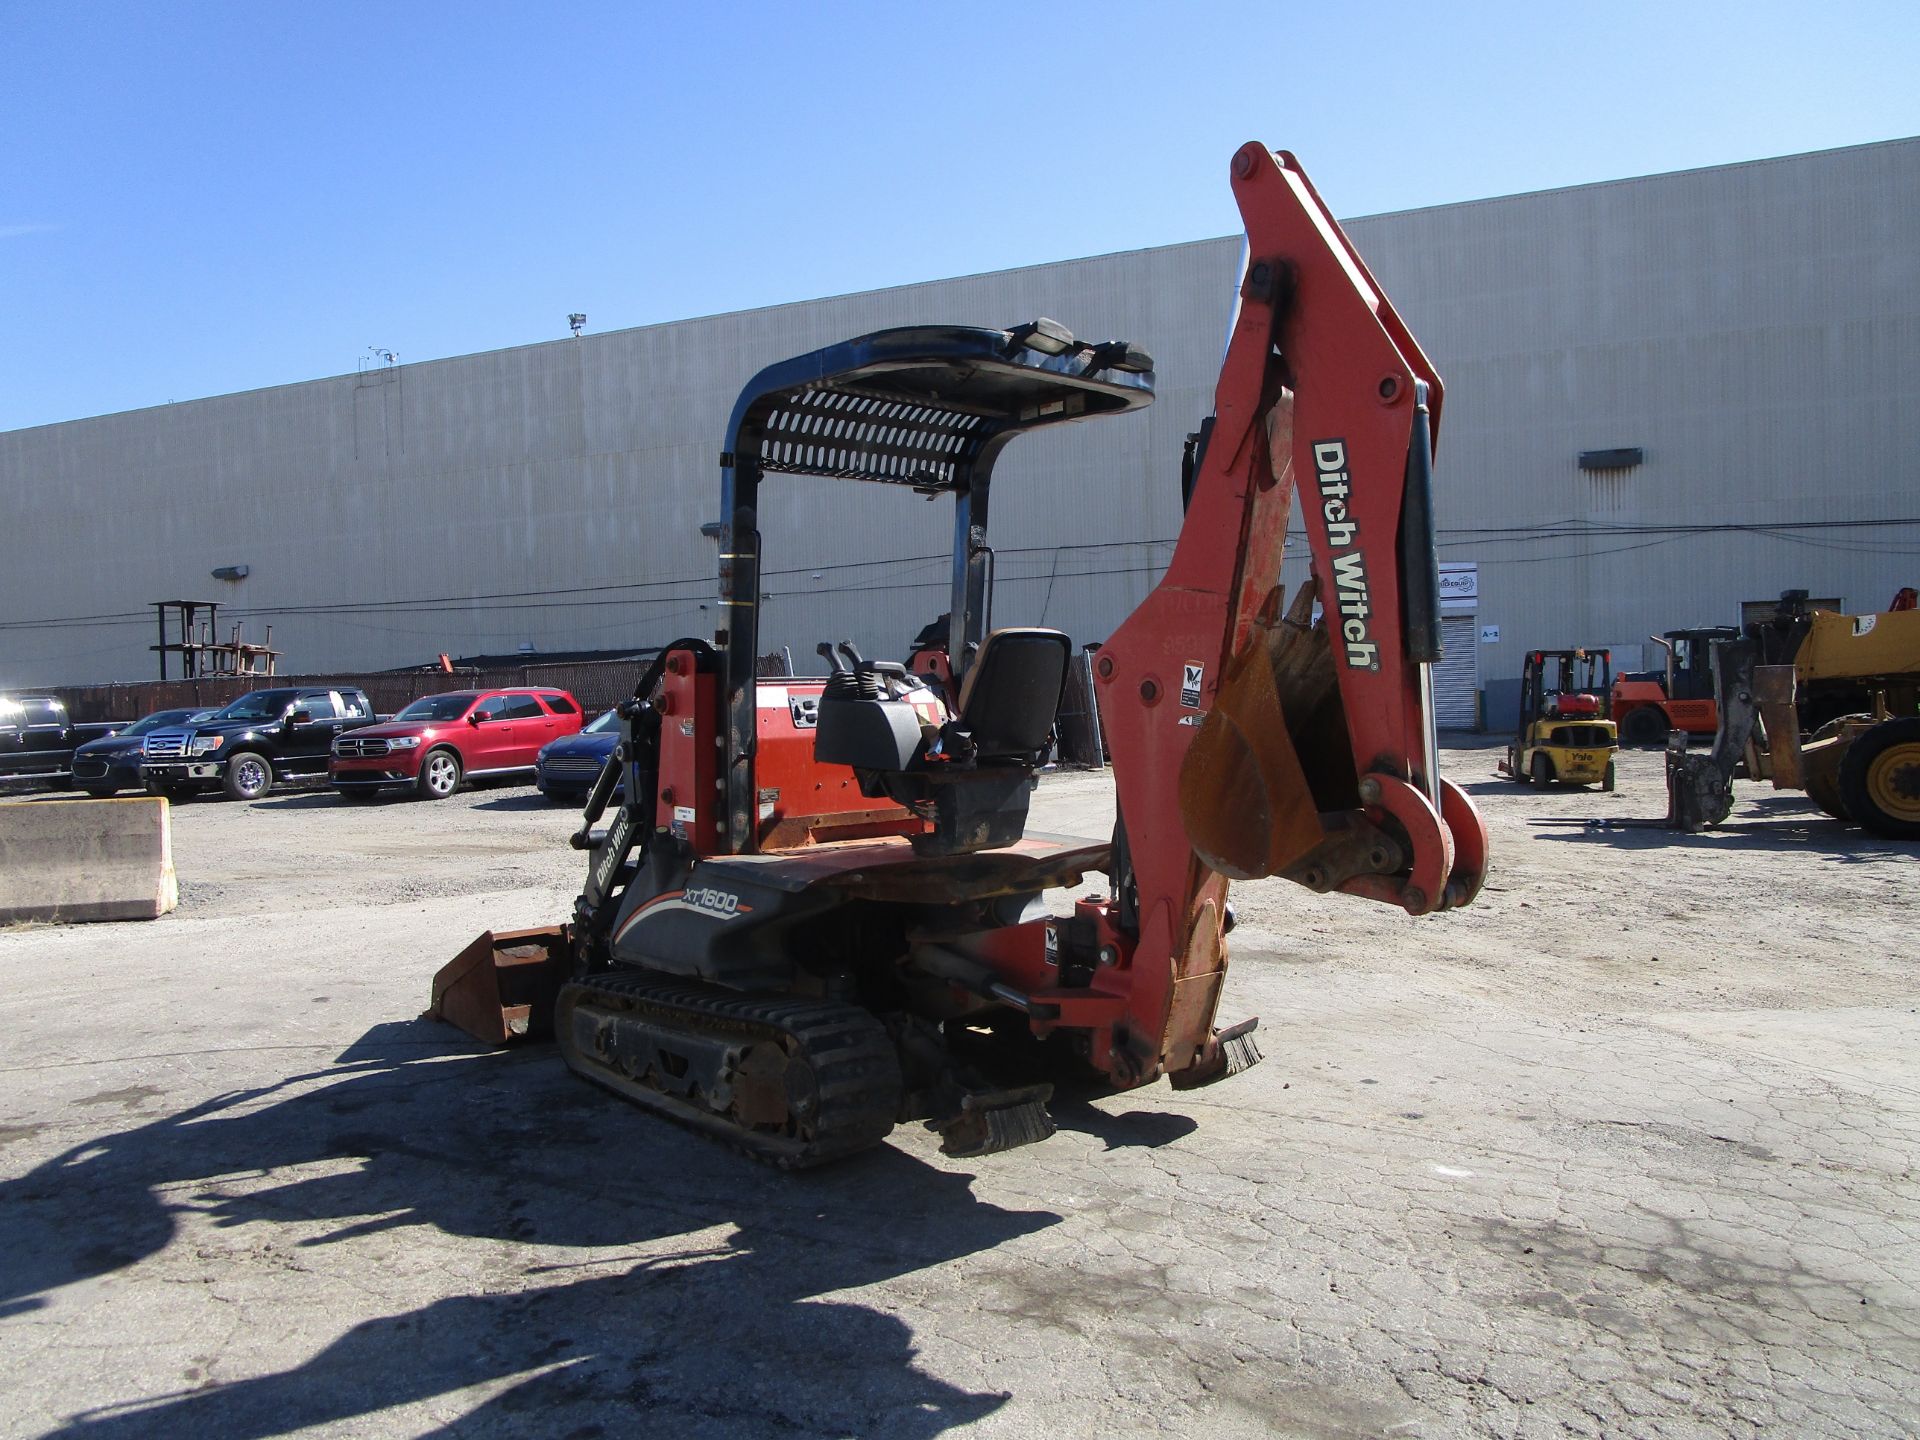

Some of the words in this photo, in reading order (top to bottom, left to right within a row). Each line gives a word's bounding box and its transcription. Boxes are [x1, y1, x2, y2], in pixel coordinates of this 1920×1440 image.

[1315, 442, 1357, 546] Ditch
[1333, 552, 1377, 667] Witch
[1572, 752, 1593, 761] Yale
[597, 847, 615, 886] Ditch
[612, 821, 629, 850] Witc
[683, 888, 738, 912] XT1600
